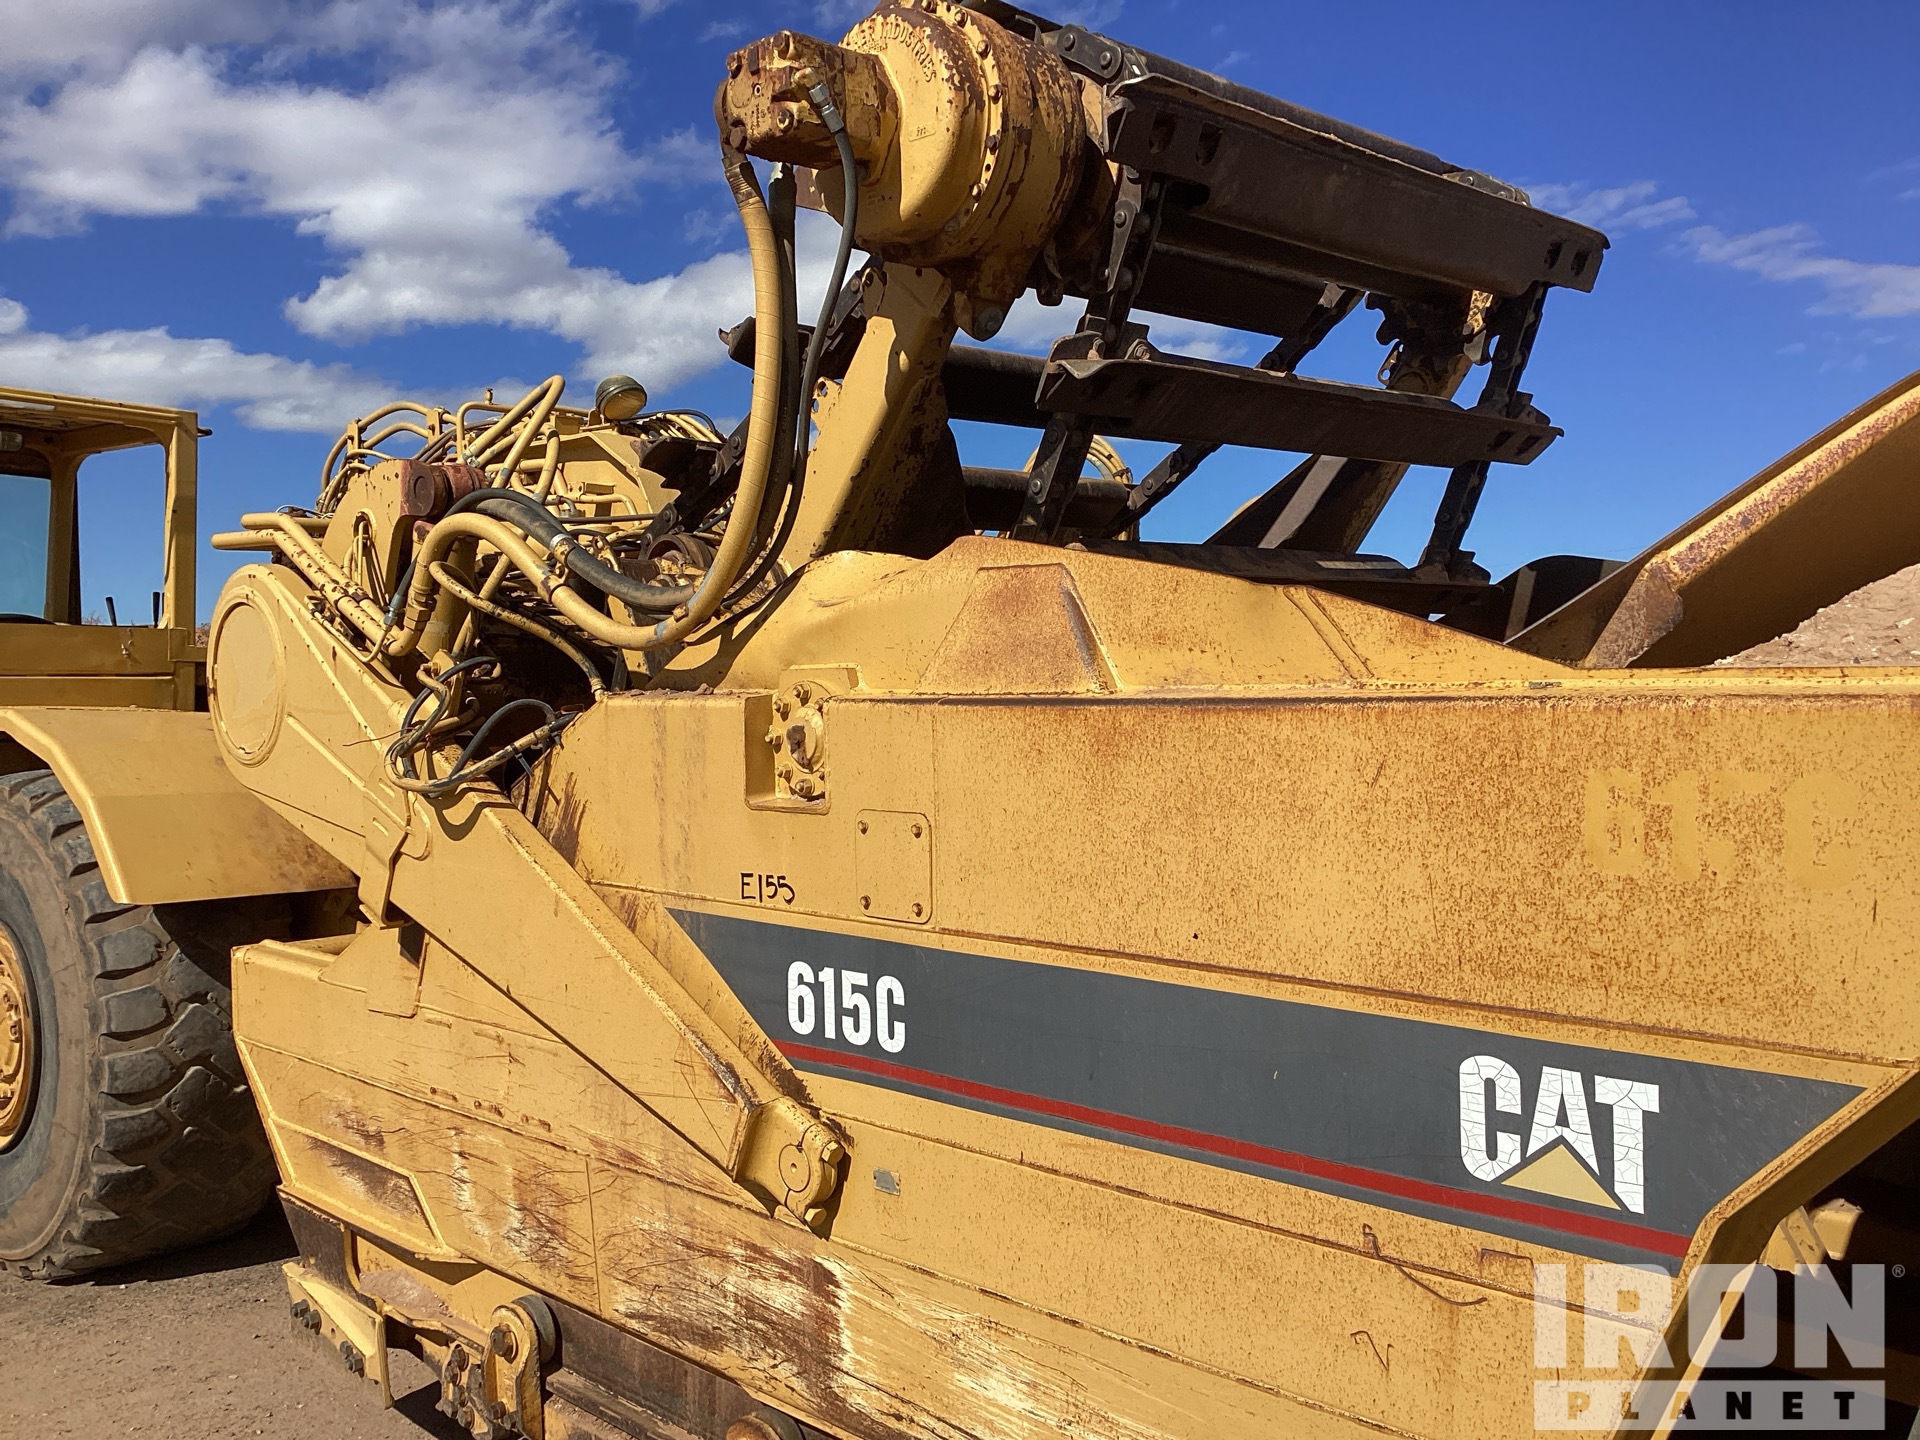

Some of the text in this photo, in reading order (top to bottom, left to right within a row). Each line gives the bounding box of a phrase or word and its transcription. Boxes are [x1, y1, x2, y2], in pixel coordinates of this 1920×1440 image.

[879, 18, 938, 83] INDUSTRIES
[740, 872, 796, 906] E155
[787, 960, 906, 1054] 615C
[1459, 1055, 1660, 1215] CAT
